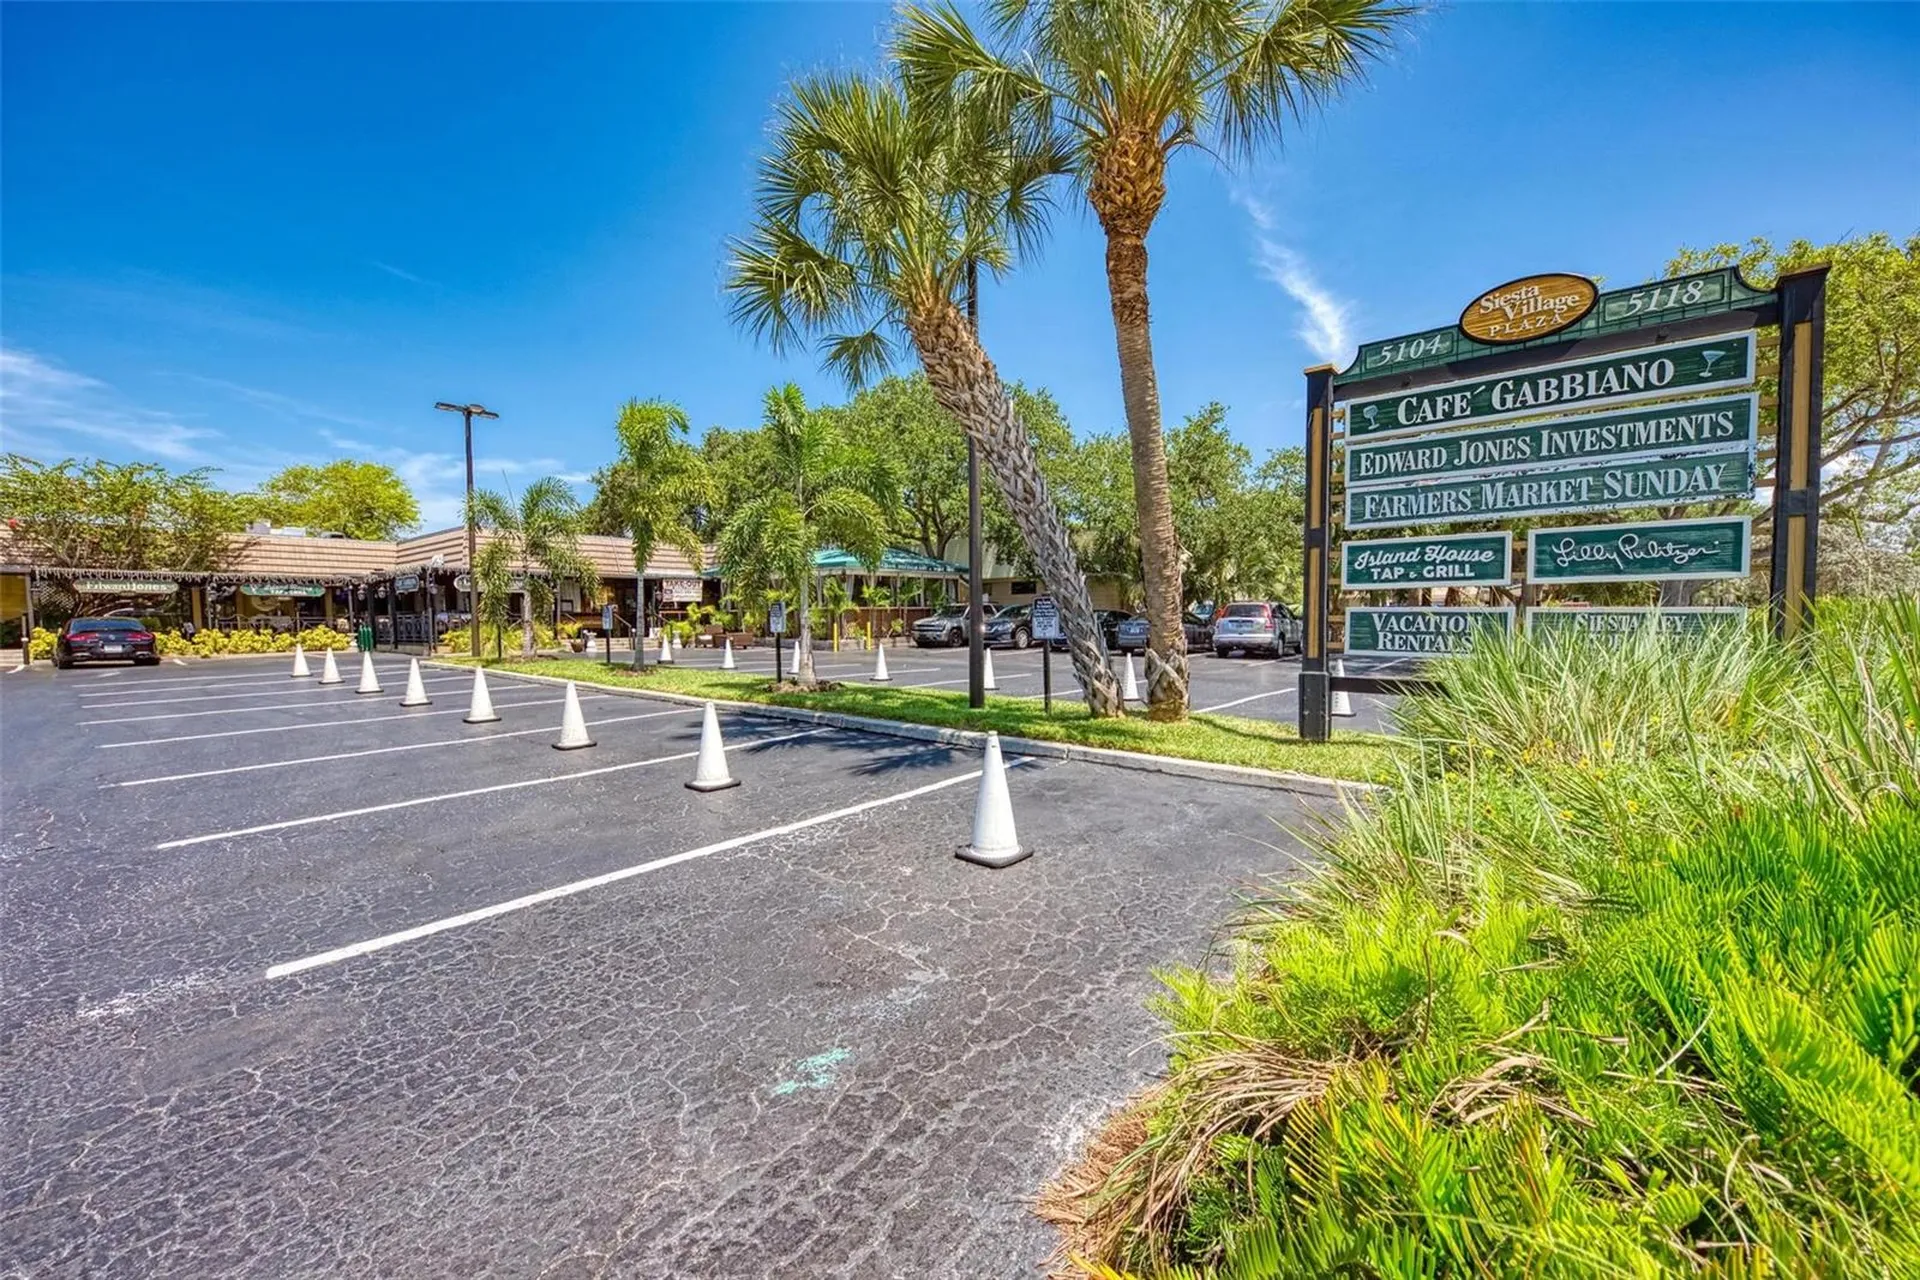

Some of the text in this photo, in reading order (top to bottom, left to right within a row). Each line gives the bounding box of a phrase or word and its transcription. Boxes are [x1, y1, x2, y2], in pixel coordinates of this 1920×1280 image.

[1479, 285, 1540, 314] Siesta
[1503, 294, 1580, 320] Village
[1623, 280, 1704, 317] 5118
[1489, 314, 1562, 337] PLAZA
[1377, 334, 1442, 367] 5104
[1491, 358, 1675, 411] GABBIANO
[1359, 410, 1735, 477] EDWARD JONES INVESTMENTS
[1363, 463, 1728, 520] FARMERS MARKET SUNDAY
[1354, 545, 1496, 570] Island House
[1552, 533, 1721, 570] Lilly Pulitzer
[1370, 564, 1475, 580] TAP & GRILL
[1372, 612, 1482, 632] VACATION
[1377, 632, 1474, 651] RENTALS
